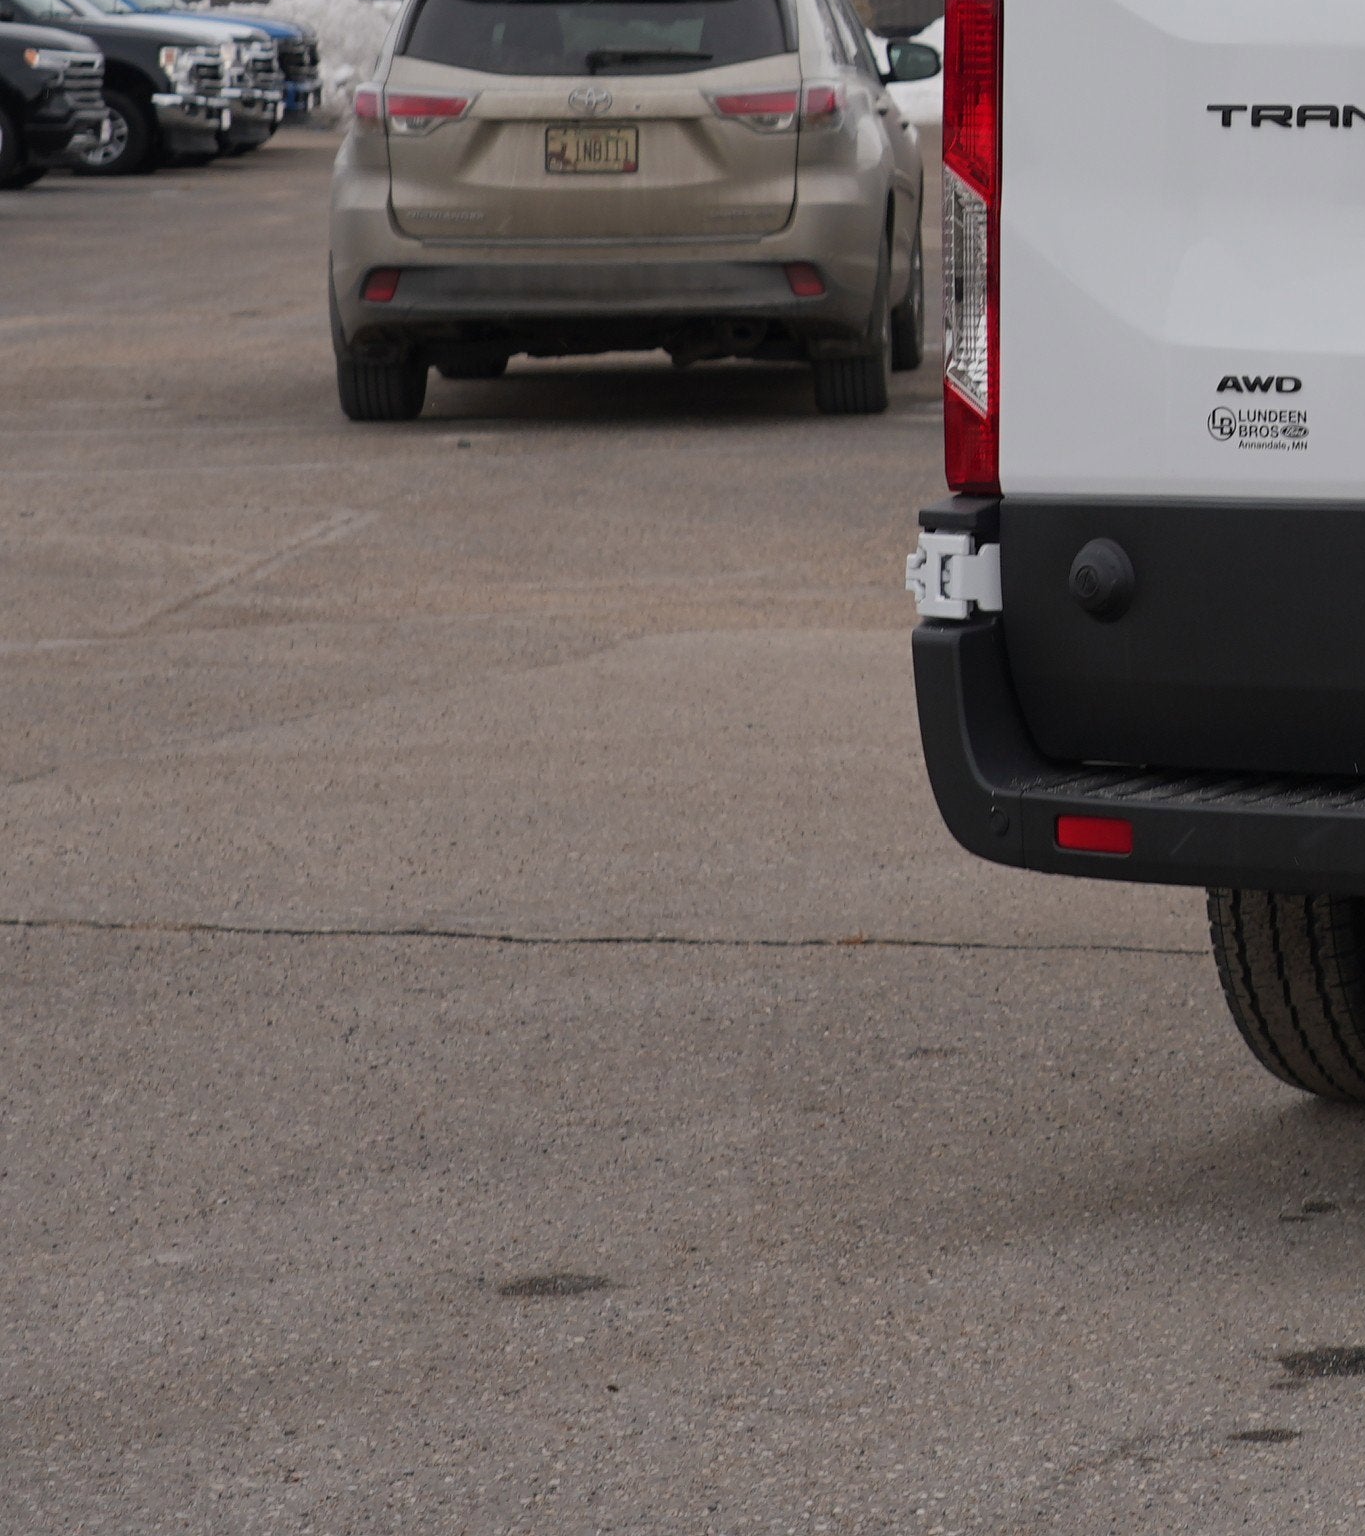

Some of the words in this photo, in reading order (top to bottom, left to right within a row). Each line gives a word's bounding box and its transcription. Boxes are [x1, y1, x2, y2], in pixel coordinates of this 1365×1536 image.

[1216, 375, 1303, 394] AWD
[1238, 409, 1307, 423] LUNDEEN
[1238, 425, 1280, 438] BROS
